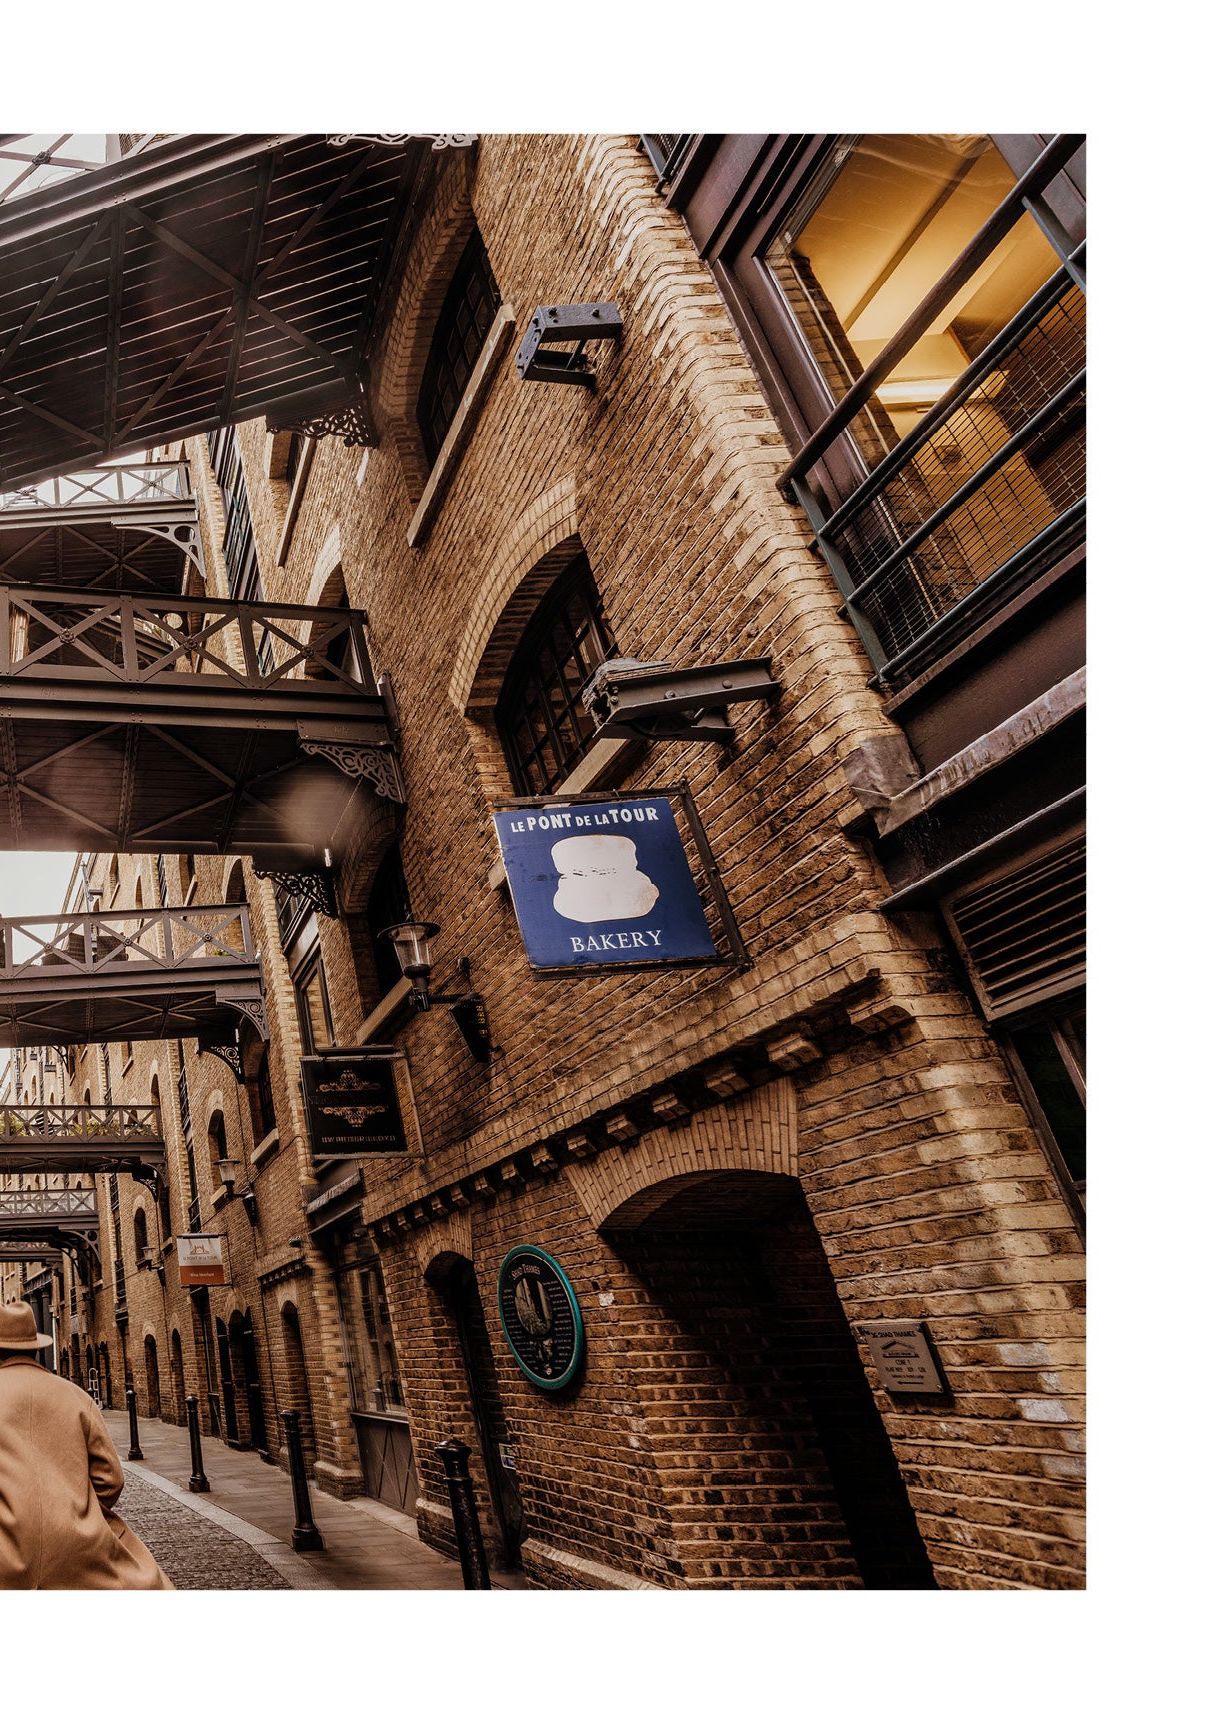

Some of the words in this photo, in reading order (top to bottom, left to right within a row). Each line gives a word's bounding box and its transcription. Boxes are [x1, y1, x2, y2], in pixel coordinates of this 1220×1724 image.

[511, 821, 525, 833] LE
[527, 813, 571, 831] PONT
[575, 815, 590, 826] DE
[595, 814, 610, 825] LA
[609, 807, 659, 823] TOUR
[570, 930, 662, 953] BAKERY
